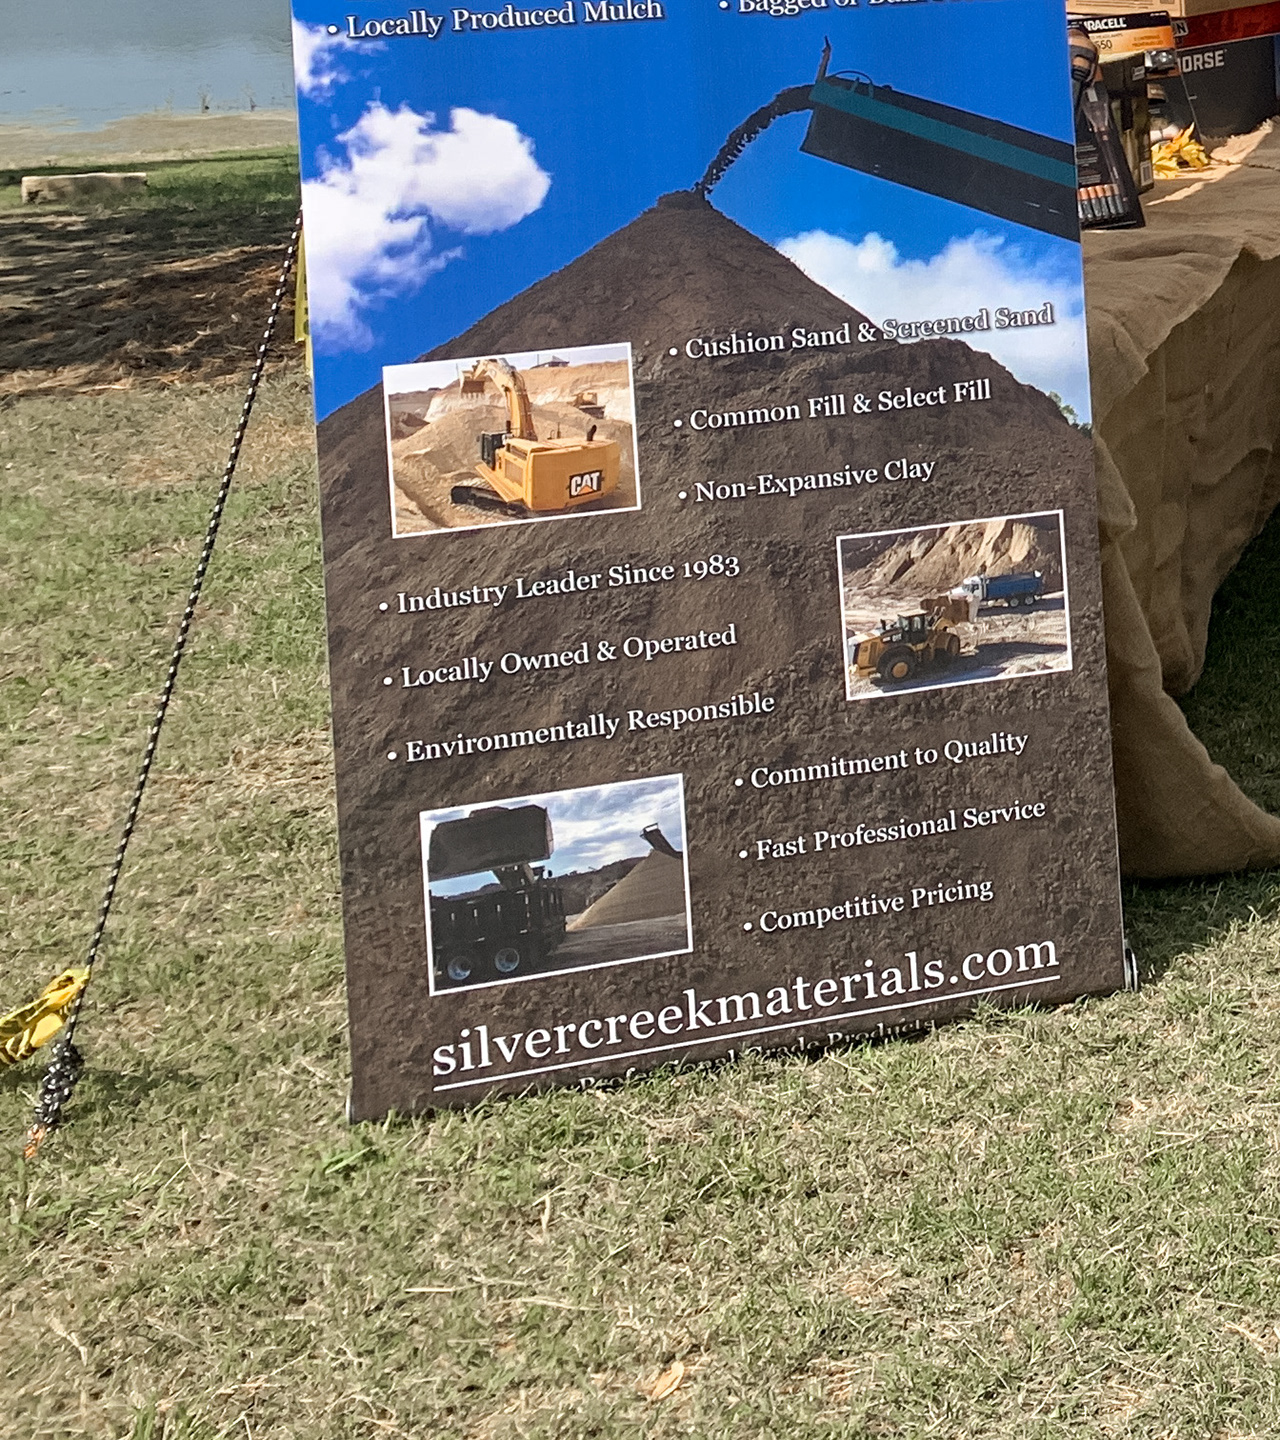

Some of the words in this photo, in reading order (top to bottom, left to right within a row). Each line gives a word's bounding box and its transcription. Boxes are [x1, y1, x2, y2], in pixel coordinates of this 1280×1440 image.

[347, 11, 444, 38] Locally
[451, 1, 575, 32] Produced
[685, 330, 785, 359] Cushion
[791, 322, 851, 348] Sand
[857, 323, 877, 343] &
[883, 308, 989, 340] Screened
[994, 303, 1054, 328] Sand
[689, 402, 801, 431] Common
[807, 392, 846, 418] Fill
[852, 393, 872, 414] &
[877, 385, 947, 411] Select
[953, 378, 991, 404] Fill
[571, 472, 600, 496] CAT
[694, 464, 878, 503] Non-Expansive
[884, 458, 935, 482] Clay
[397, 585, 507, 614] Industry
[515, 572, 602, 599] Leader
[608, 562, 675, 587] Since
[681, 554, 740, 579] 1983
[401, 657, 494, 688] Locally
[500, 641, 590, 674] Owned
[596, 640, 617, 661] &
[623, 623, 737, 661] Operated
[405, 715, 620, 763] Environmentally
[627, 691, 775, 731] Responsible
[750, 751, 909, 789] Commitment
[914, 746, 938, 766] to
[943, 731, 1029, 763] Quality
[756, 836, 807, 860] Fast
[813, 810, 957, 850] Professional
[962, 800, 1046, 829] Service
[759, 893, 904, 934] Competitive
[910, 878, 994, 910] Pricing
[431, 939, 1060, 1078] silvercreekmaterials.com
